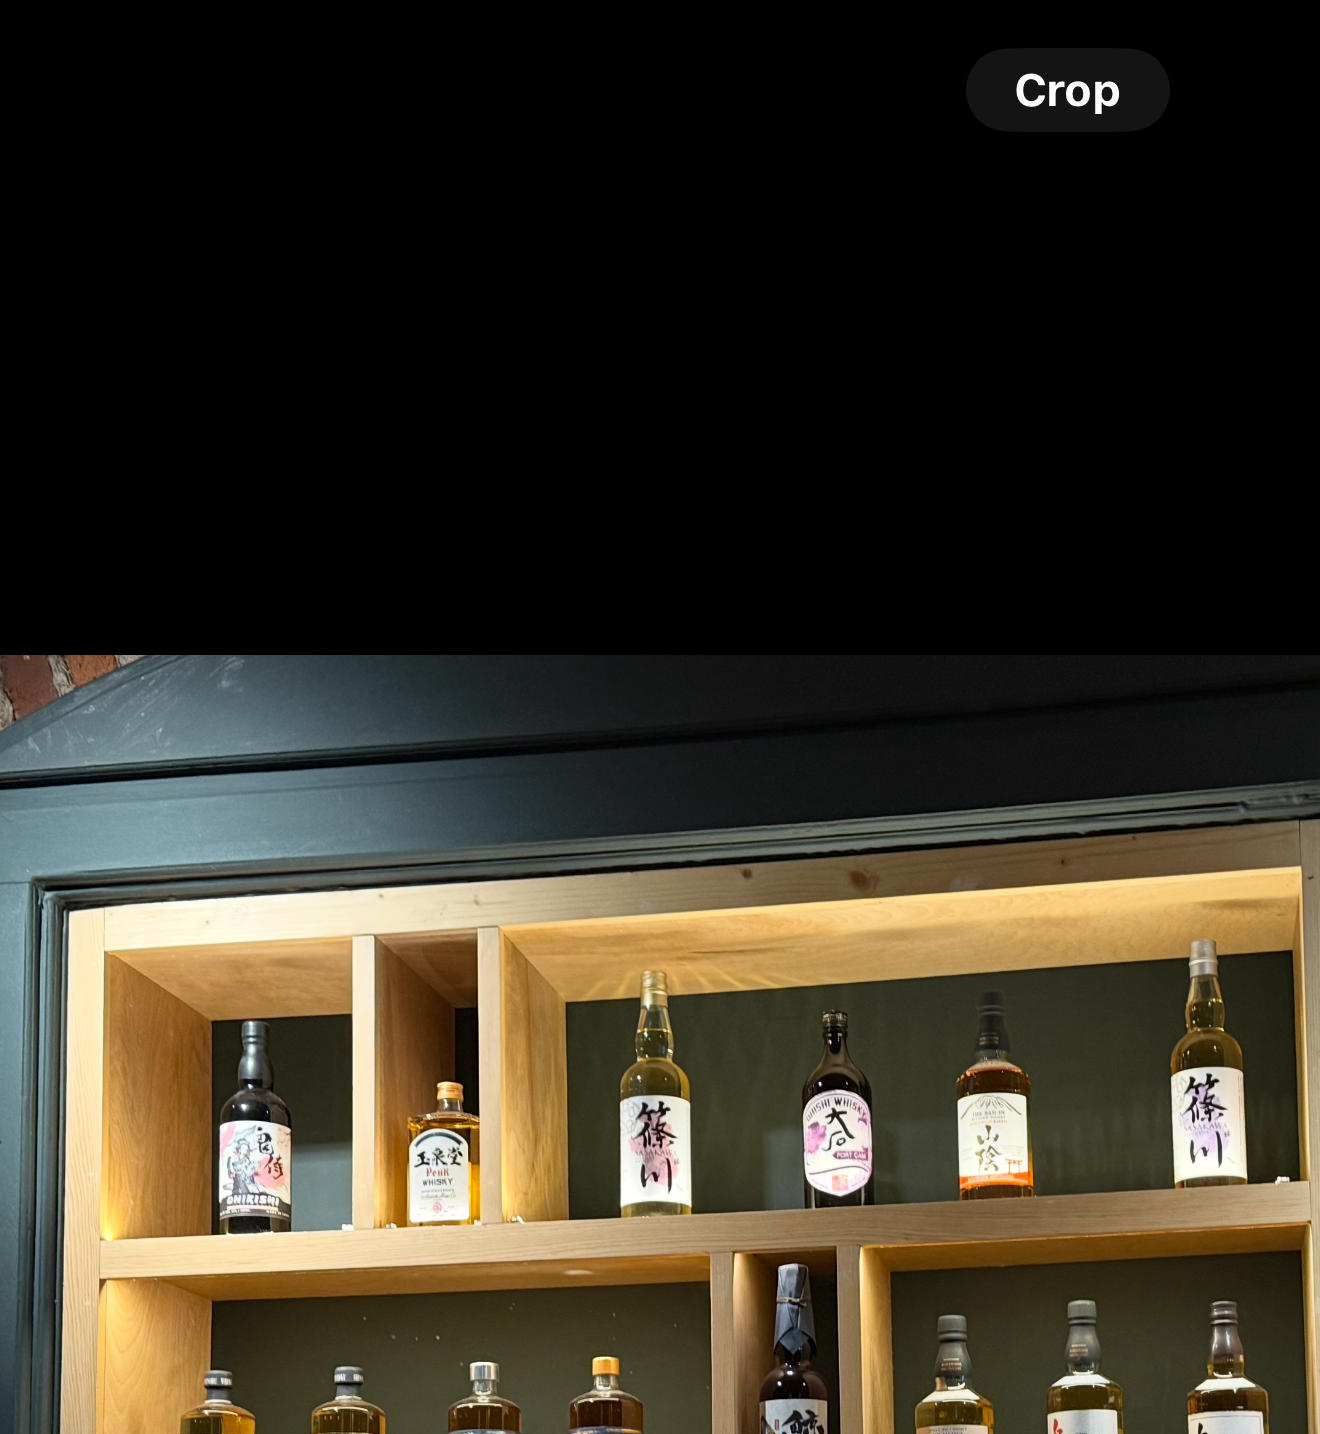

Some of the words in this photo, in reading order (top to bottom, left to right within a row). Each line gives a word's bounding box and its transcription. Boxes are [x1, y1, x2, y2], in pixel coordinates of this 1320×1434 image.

[833, 1096, 868, 1118] WHISKY
[836, 1151, 853, 1160] PORT
[422, 1177, 454, 1187] WHISKY
[227, 1193, 280, 1206] ONIKISHI
